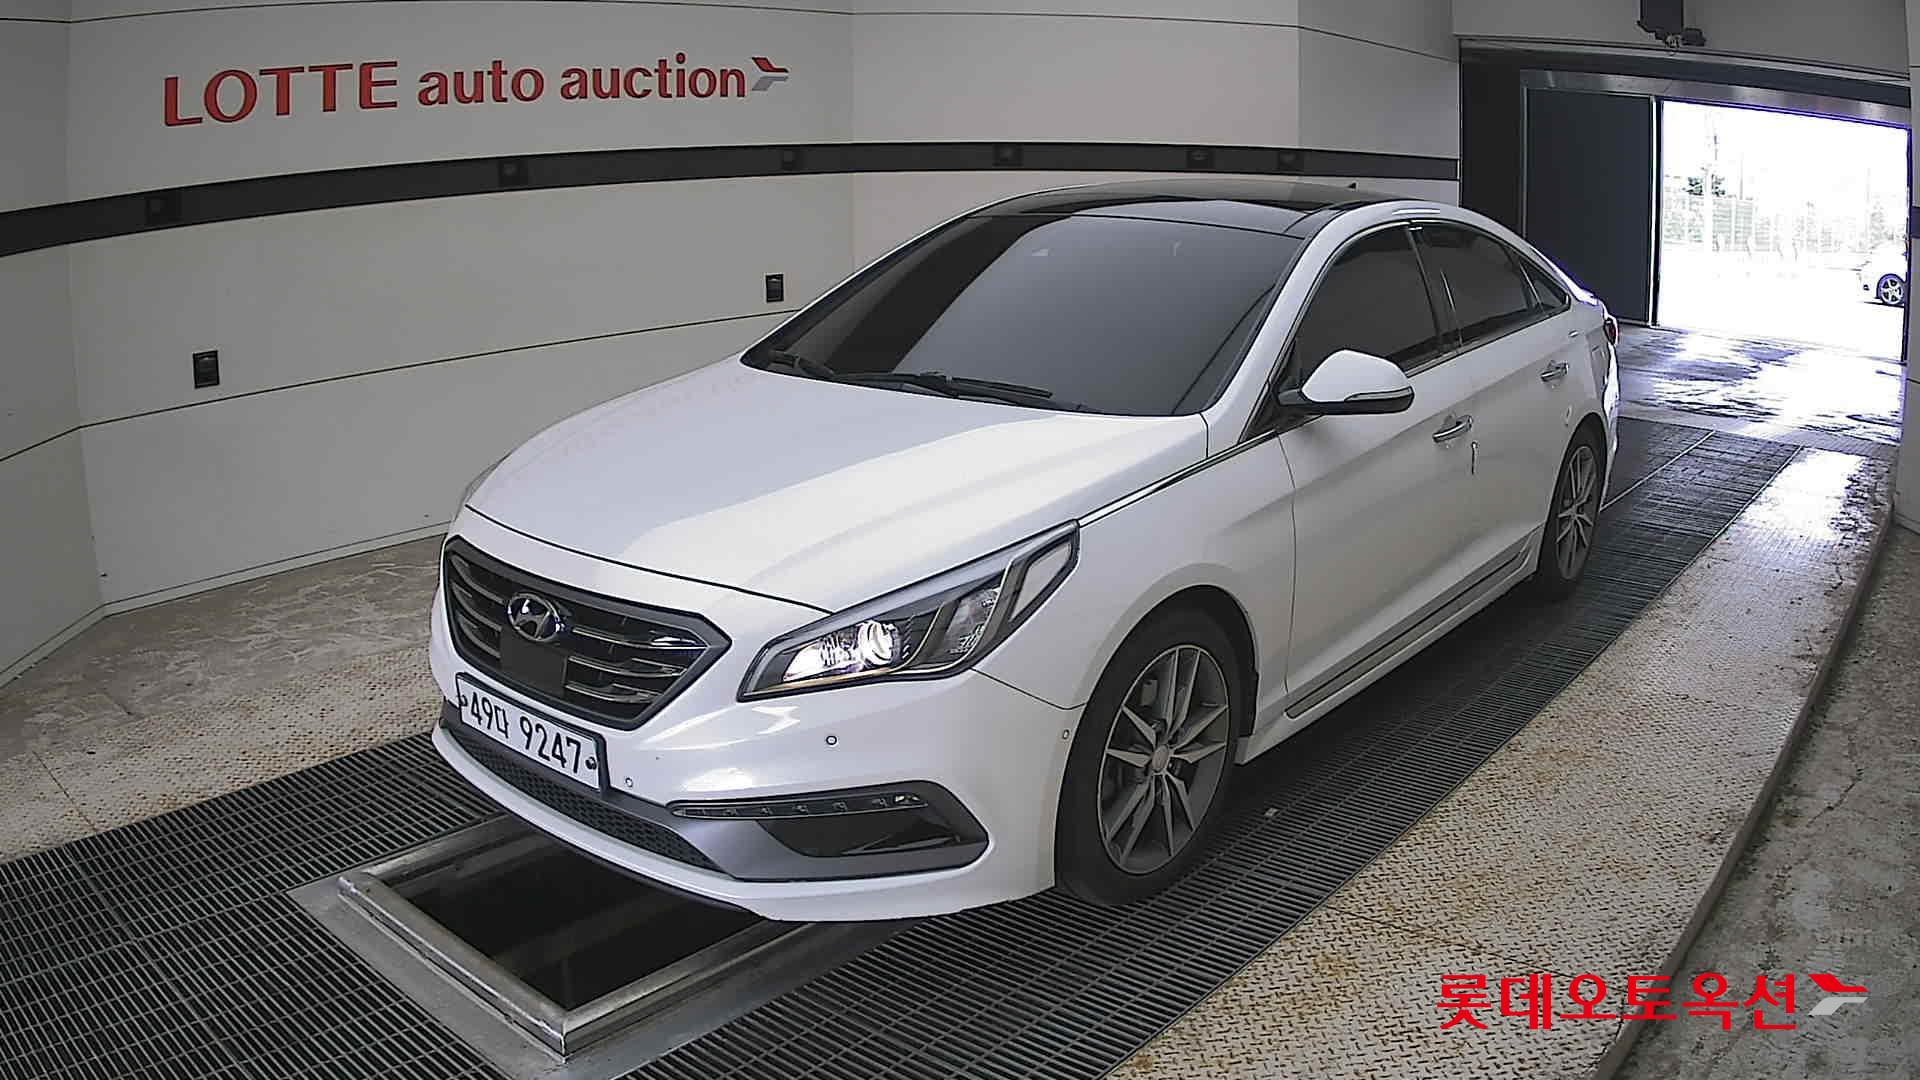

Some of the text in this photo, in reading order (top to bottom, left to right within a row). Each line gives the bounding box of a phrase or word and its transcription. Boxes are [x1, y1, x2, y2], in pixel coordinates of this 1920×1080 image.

[164, 53, 746, 127] LOTTE auto auction
[519, 716, 581, 773] 9247
